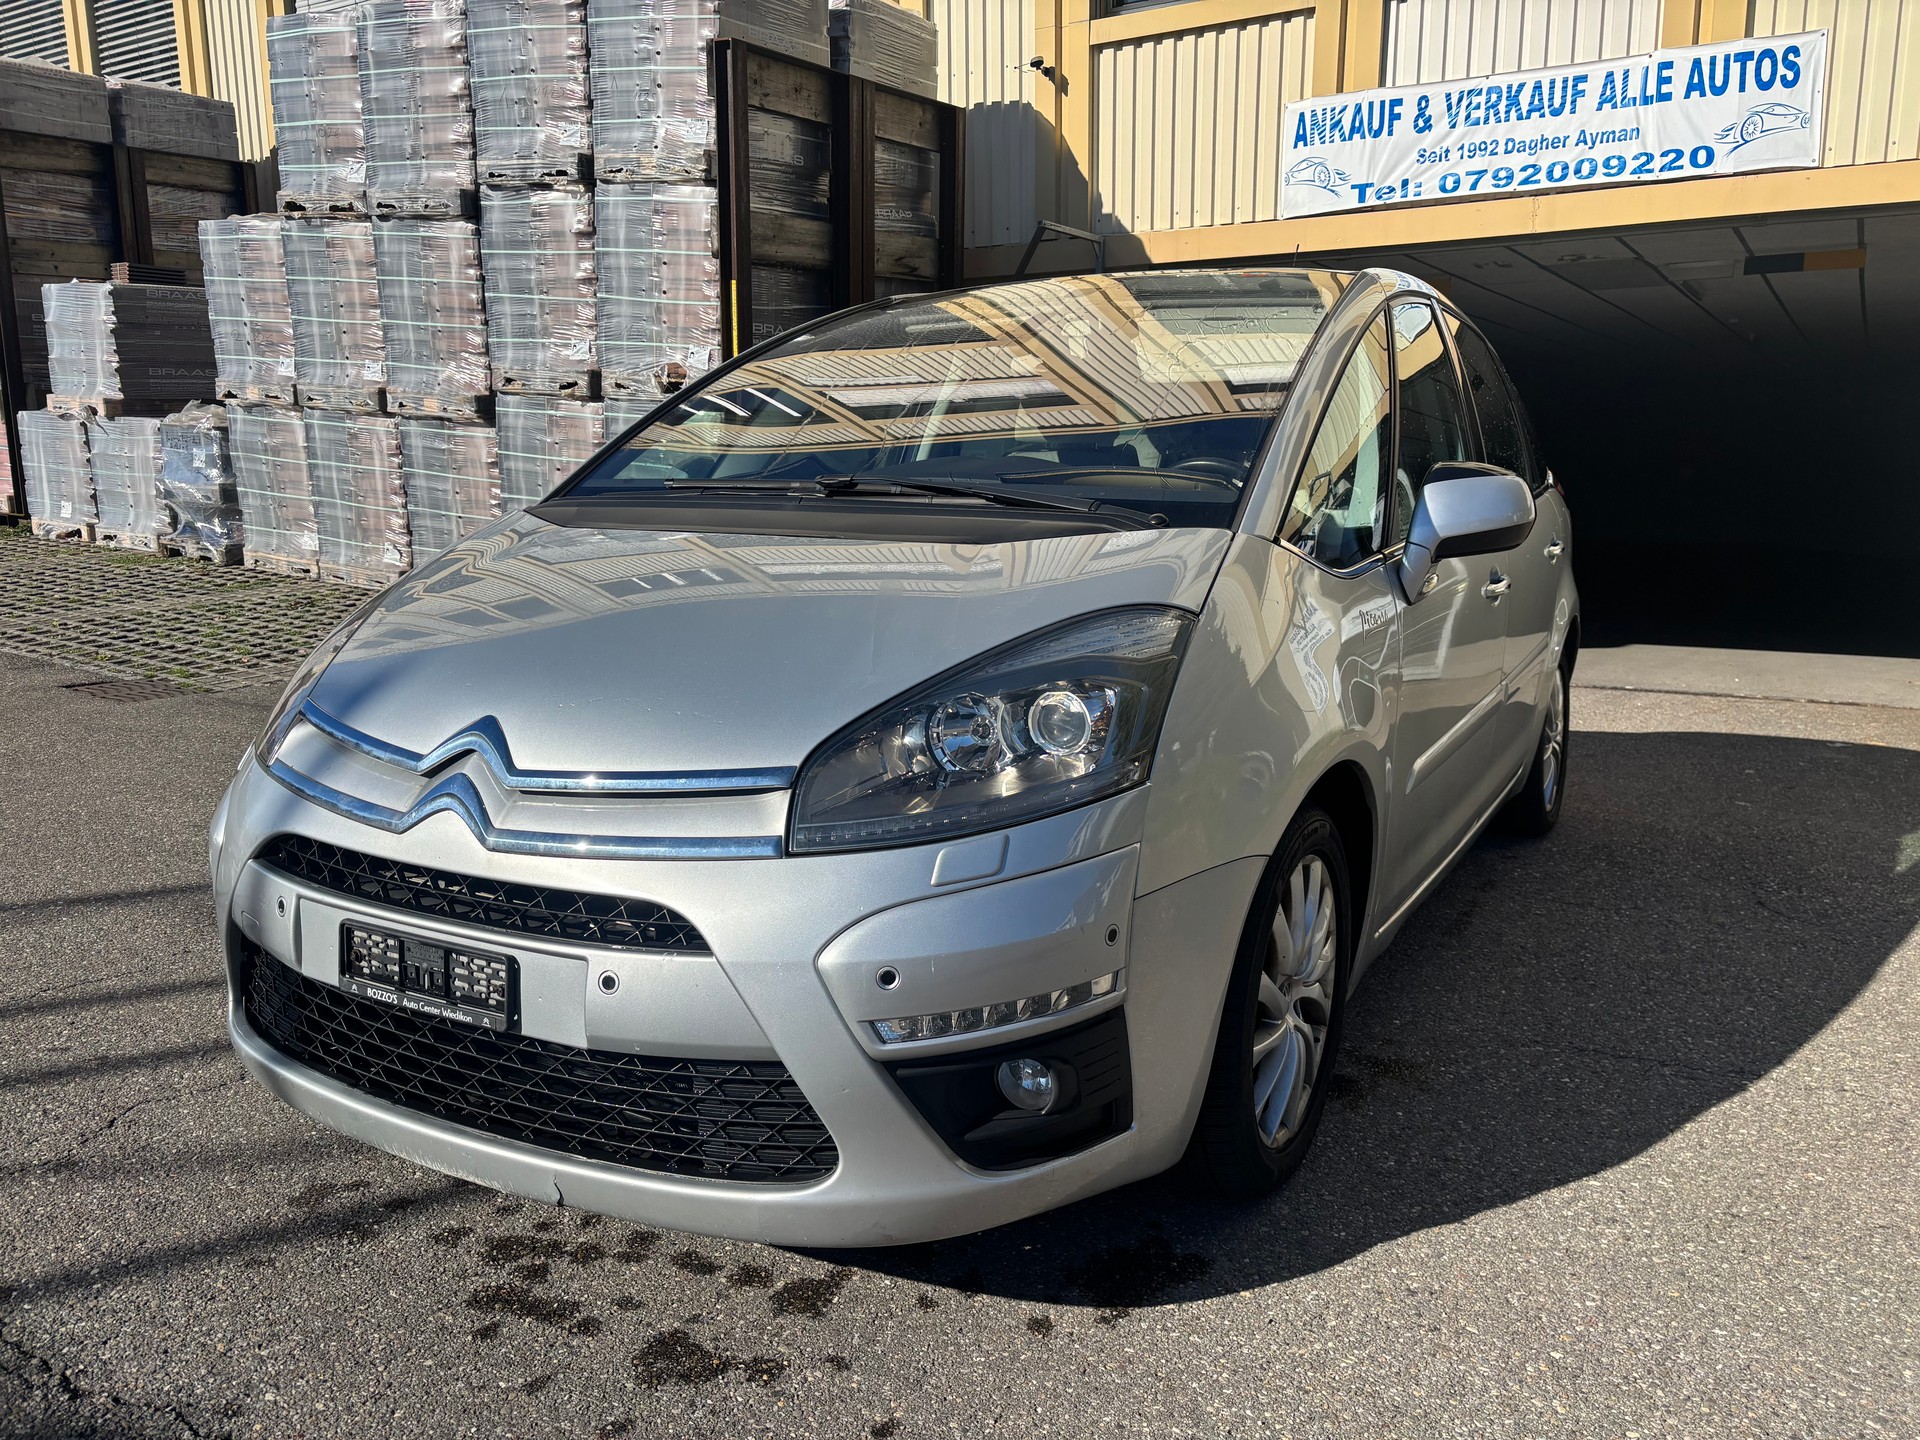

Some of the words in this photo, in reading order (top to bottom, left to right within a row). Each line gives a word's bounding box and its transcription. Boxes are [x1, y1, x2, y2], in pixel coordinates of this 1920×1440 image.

[1293, 98, 1404, 149] ANKAUF
[1413, 95, 1433, 134] &
[1445, 74, 1588, 129] VERKAUF
[1596, 61, 1674, 111] ALLE
[1684, 45, 1801, 100] AUTOS
[1416, 145, 1451, 165] Seit
[1457, 139, 1499, 160] 1992
[1504, 133, 1570, 156] Dagher
[1574, 126, 1640, 150] Ayman
[1350, 178, 1423, 204] Tel:
[1438, 145, 1715, 194] 0792009220
[149, 368, 217, 377] BRAAS
[367, 987, 398, 1004] BOZZO'S
[402, 997, 418, 1010] Auto
[420, 1002, 440, 1015] Center
[442, 1007, 473, 1023] Wiedikon
